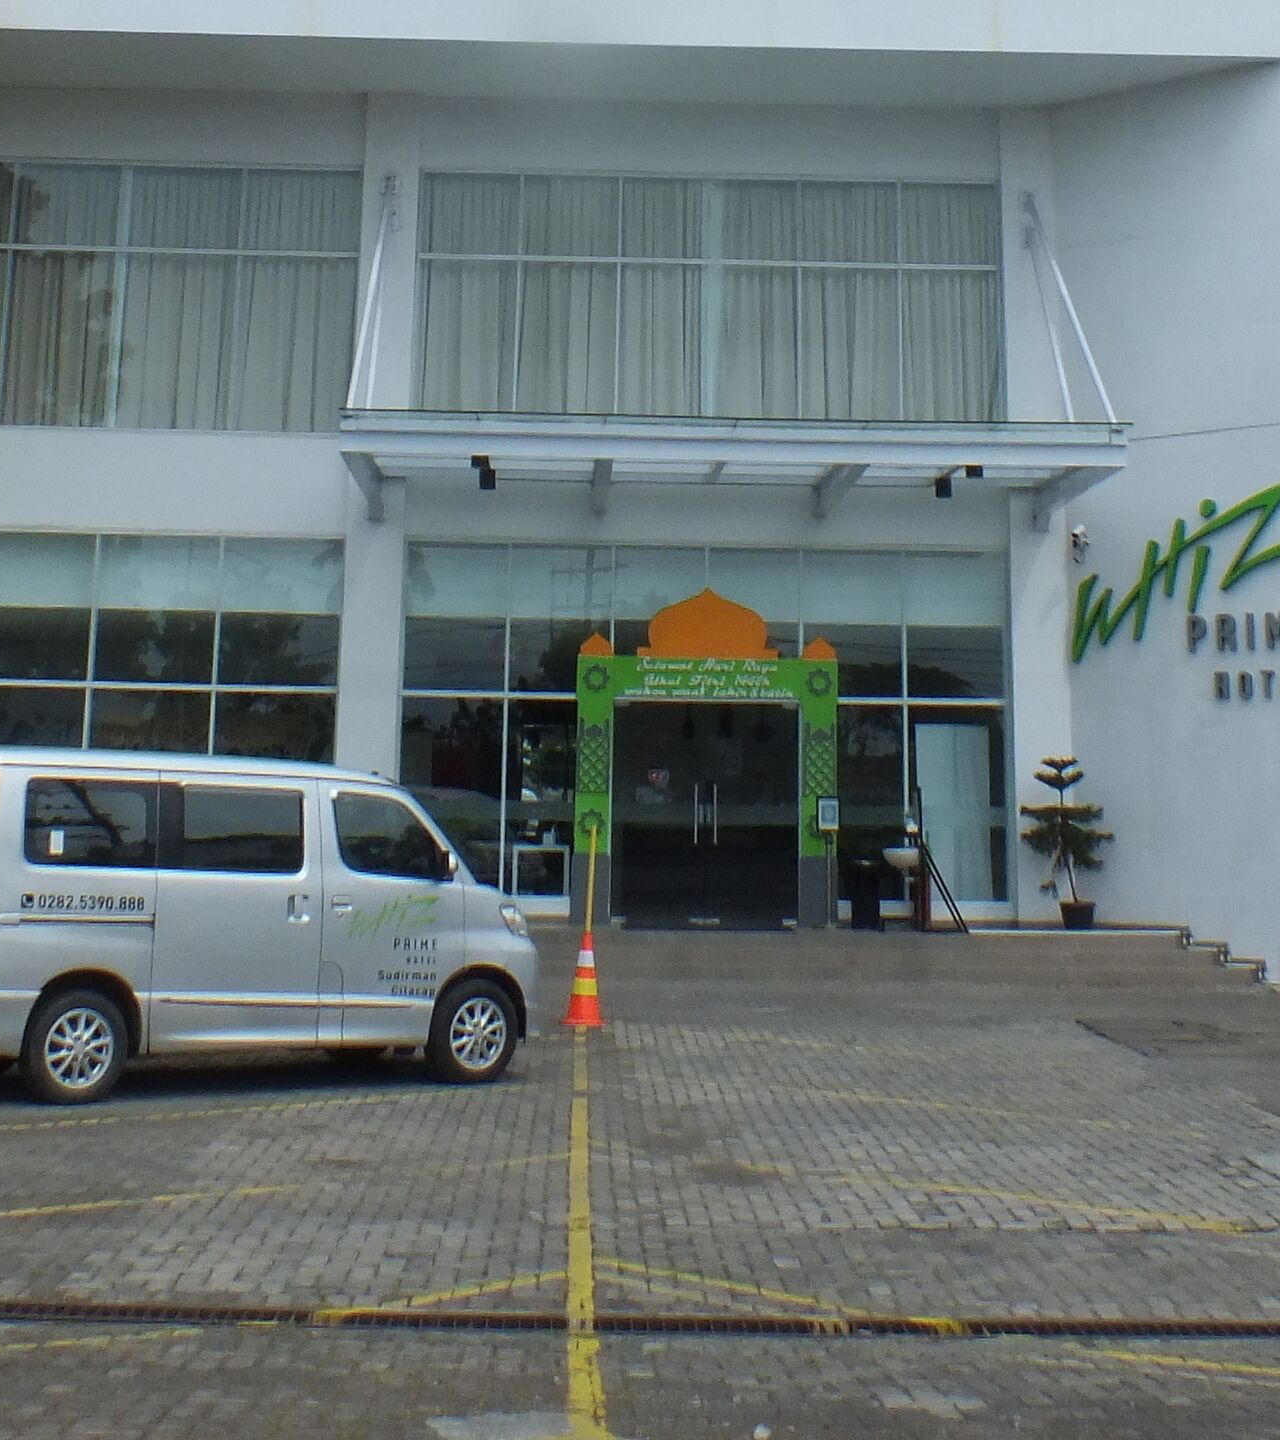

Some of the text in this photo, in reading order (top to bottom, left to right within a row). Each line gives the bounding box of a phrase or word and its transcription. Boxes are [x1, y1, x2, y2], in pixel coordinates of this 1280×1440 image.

[37, 893, 146, 911] 0282.5390.888
[393, 937, 438, 951] PRIME
[377, 969, 437, 981] Sudirman
